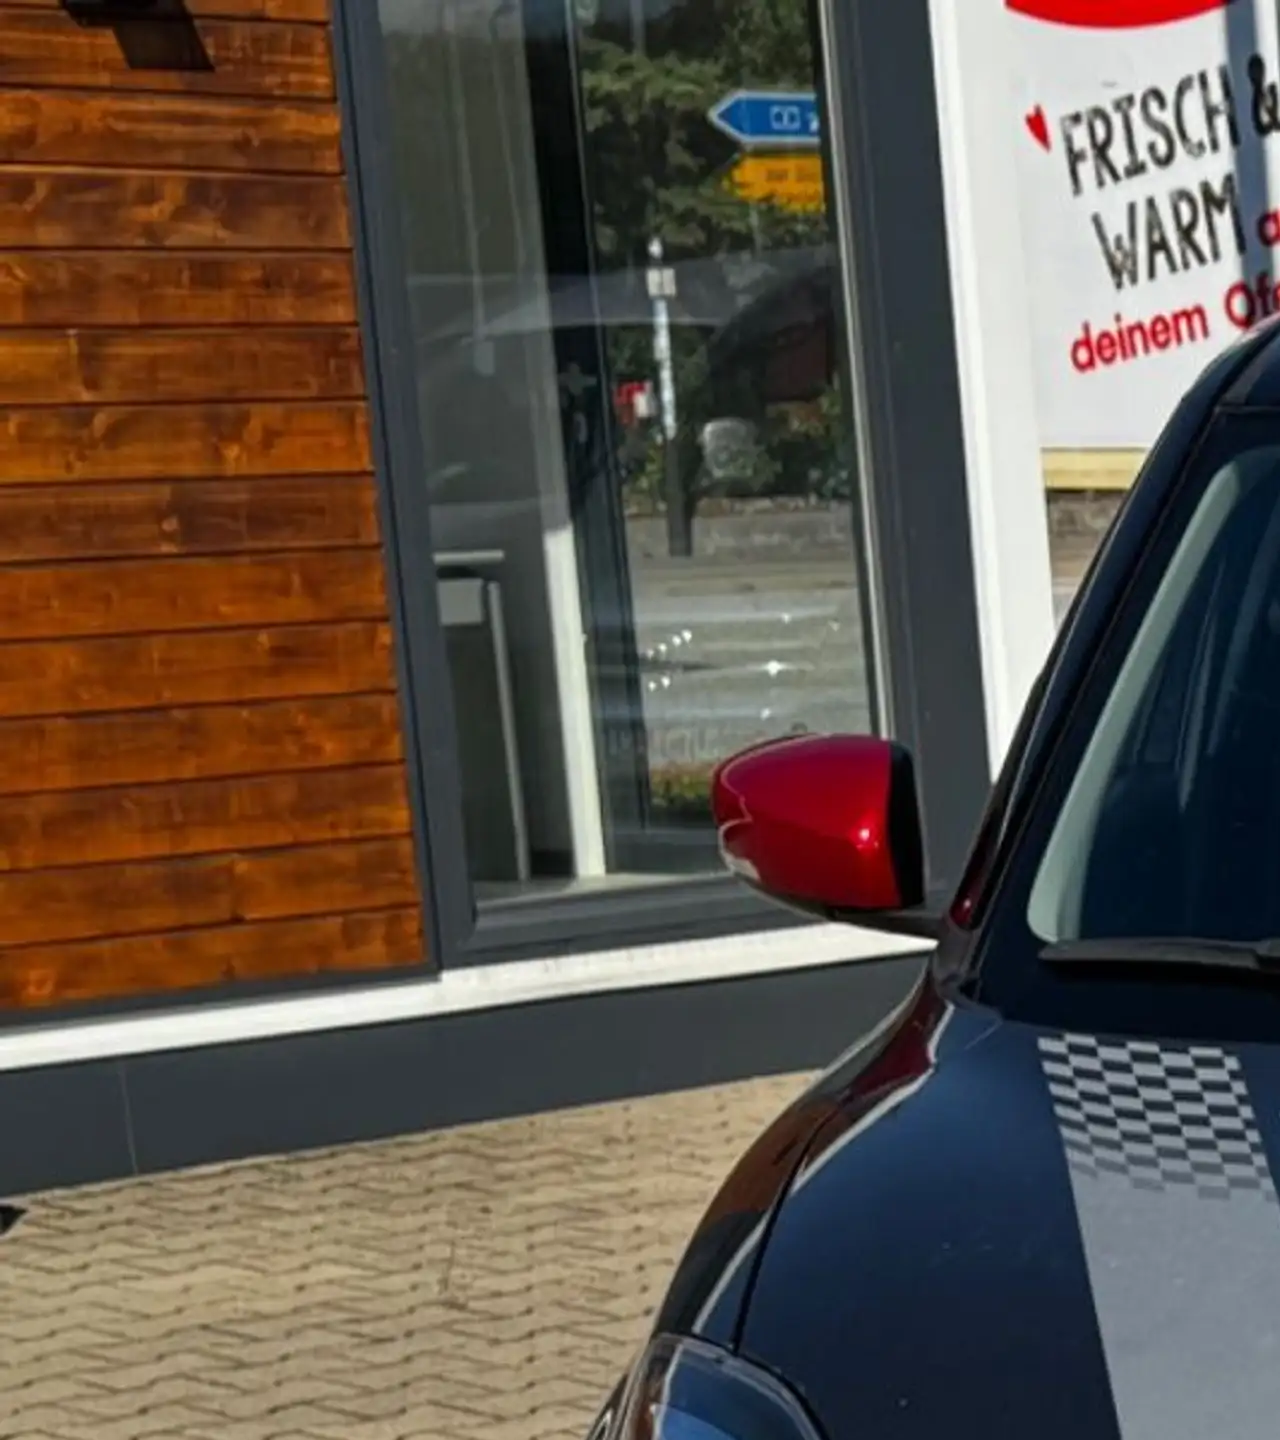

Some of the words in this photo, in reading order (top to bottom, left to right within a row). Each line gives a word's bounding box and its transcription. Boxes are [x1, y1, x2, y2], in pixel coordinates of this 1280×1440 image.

[1060, 64, 1241, 197] FRISCH
[1091, 173, 1247, 292] WARM
[1070, 304, 1210, 374] deinem
